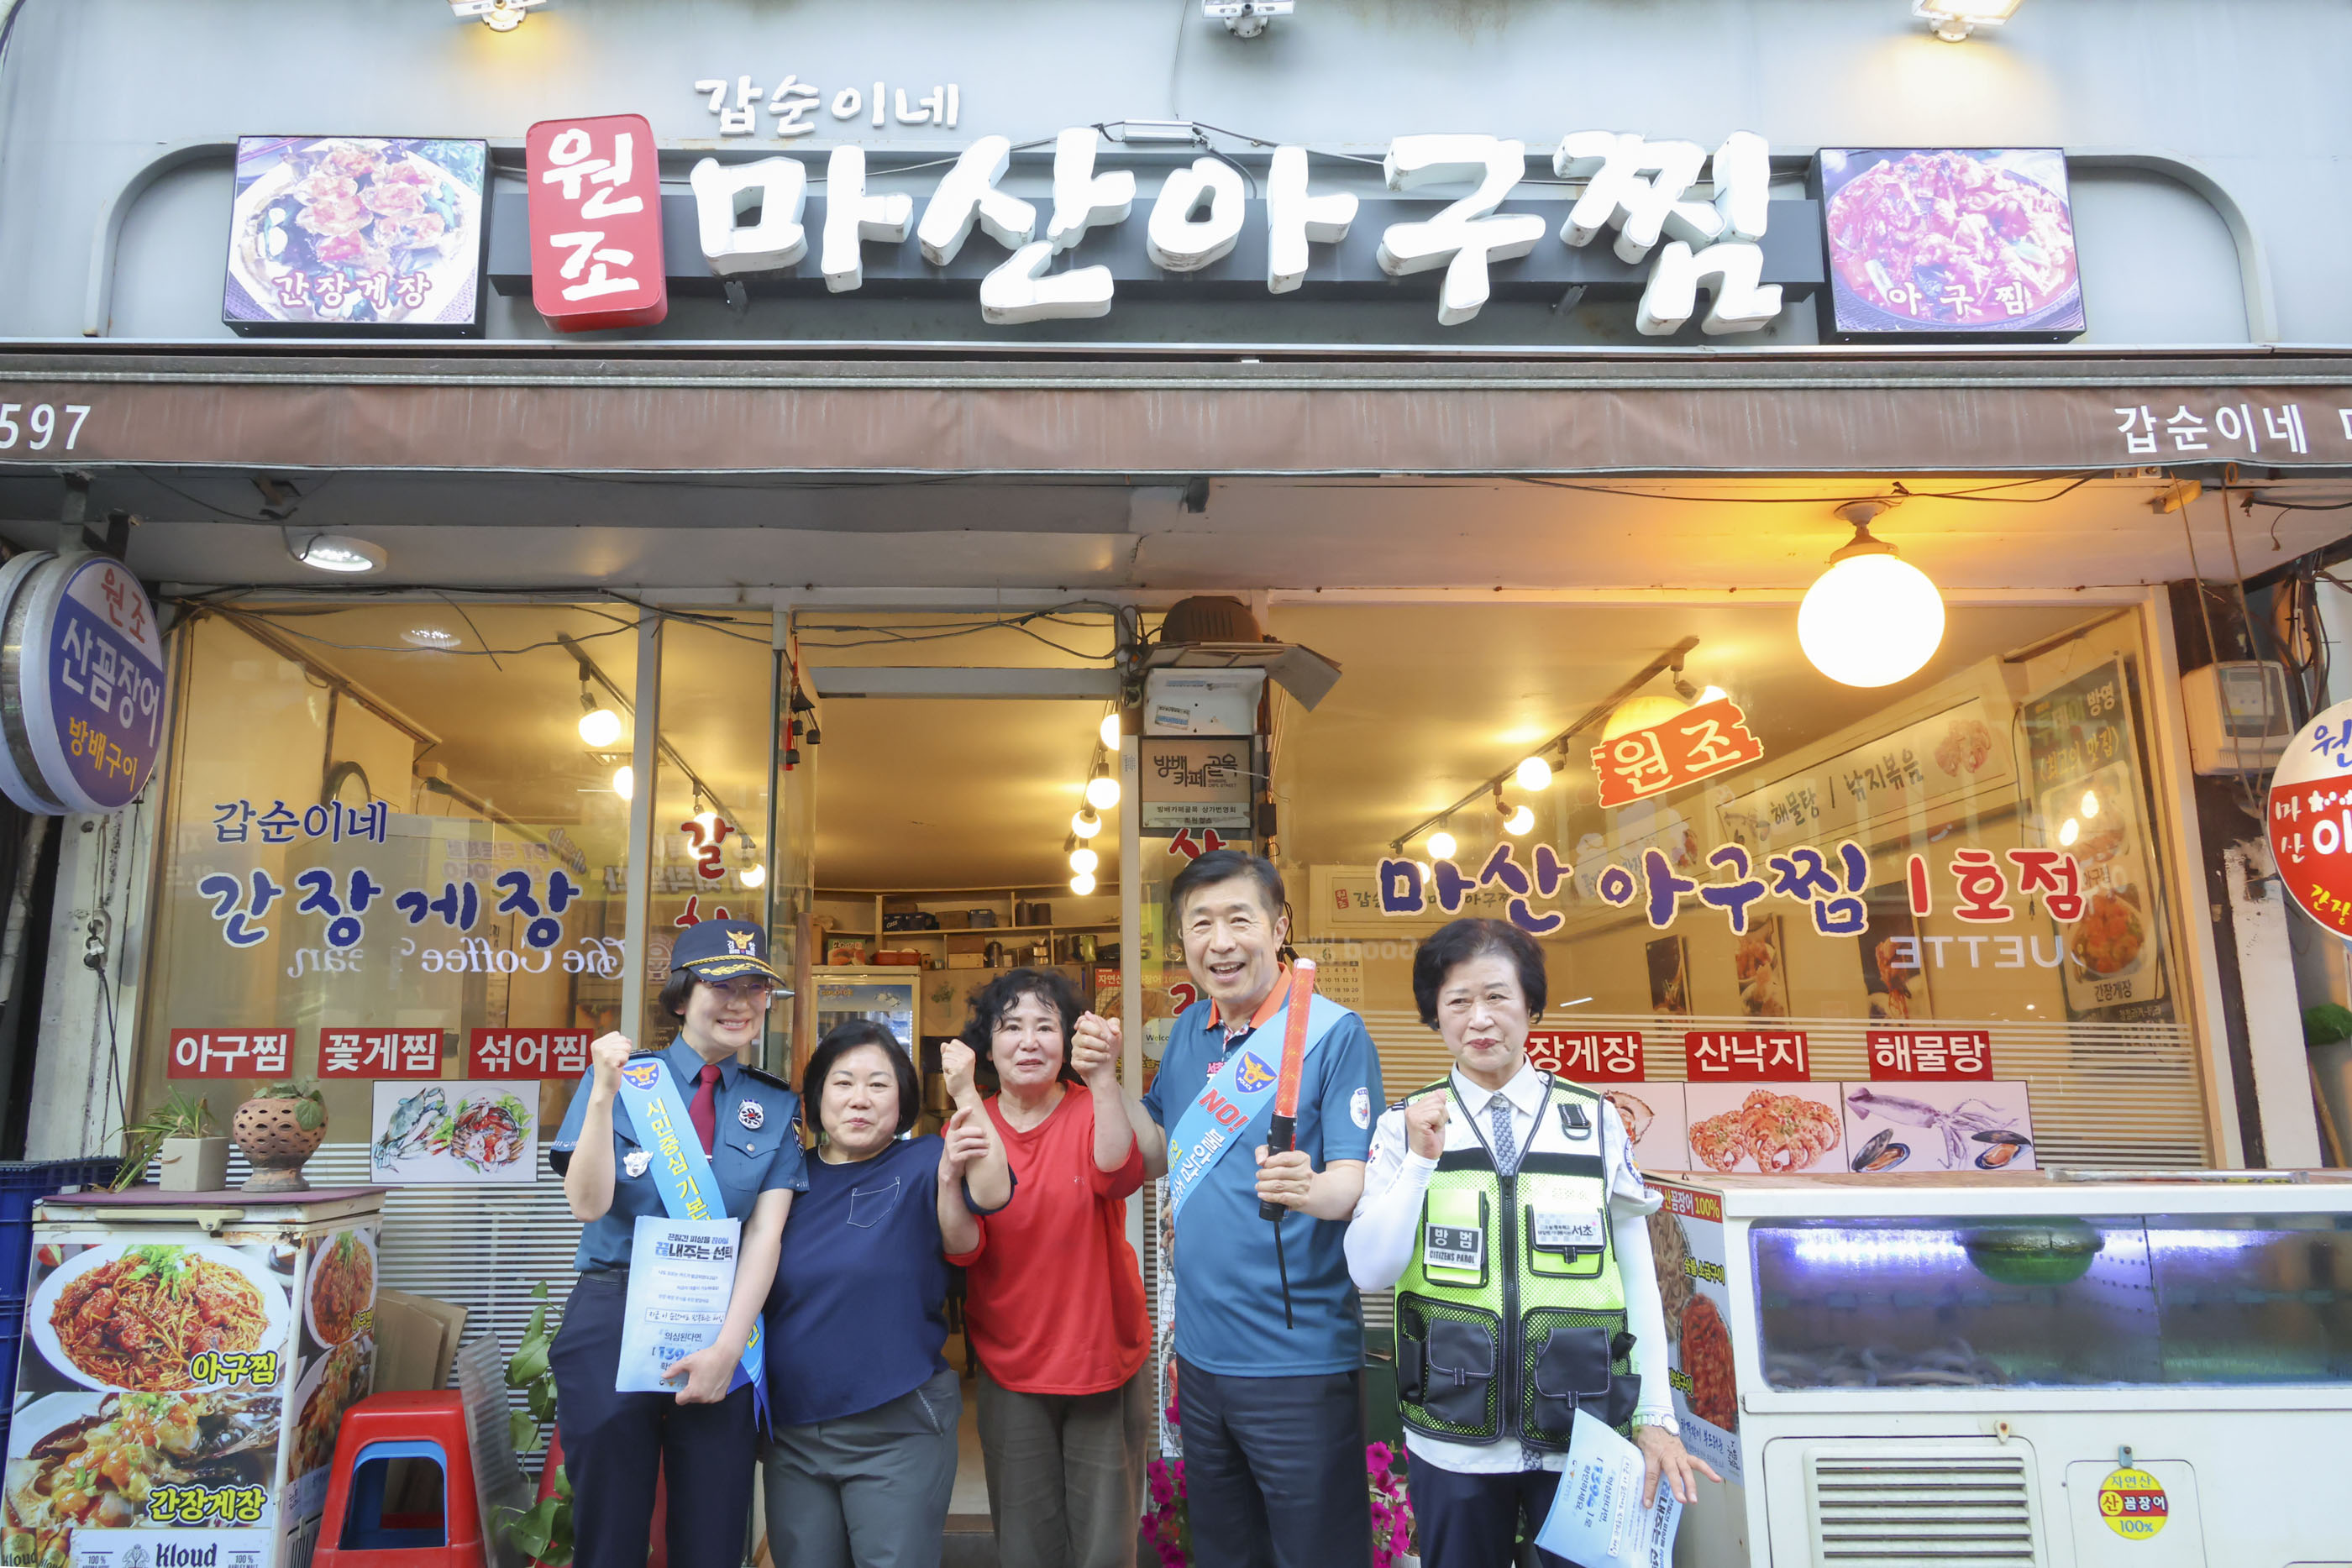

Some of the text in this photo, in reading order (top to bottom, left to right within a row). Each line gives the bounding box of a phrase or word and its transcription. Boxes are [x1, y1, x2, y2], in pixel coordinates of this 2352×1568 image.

[695, 74, 960, 138] 갑순이네
[542, 128, 644, 302] 원조
[690, 127, 1783, 335] 마산아구찜
[271, 271, 432, 311] 간장게장
[1887, 281, 2030, 316] 아구찜
[2113, 404, 2308, 454] 갑순이네
[101, 568, 145, 644] 원조
[2087, 681, 2115, 716] 방영
[69, 716, 138, 792] 방배구이
[1614, 720, 1740, 794] 원조
[213, 800, 386, 844] 갑순이네
[1771, 788, 1820, 826] 해물탕
[1377, 842, 1573, 936] 마산
[1597, 840, 1869, 936] 아구찜
[197, 867, 582, 950] 간장게장
[2094, 980, 2132, 1003] 간장게장
[176, 1034, 288, 1072] 아구찜
[324, 1033, 437, 1072] 꽃게찜
[476, 1033, 586, 1072] 섞어찜
[1524, 1035, 1638, 1073] 장게장
[1694, 1035, 1804, 1073] 산낙지
[1874, 1034, 1984, 1072] 해물탕
[1199, 1088, 1249, 1133] NO!
[646, 1097, 712, 1221] 시민중심 기본
[1694, 1197, 1720, 1219] 100%
[1572, 1225, 1593, 1236] 서초
[1698, 1260, 1725, 1285] 소금구이
[659, 1346, 693, 1361] 139
[664, 1332, 703, 1342] 의심된다면,
[189, 1350, 280, 1385] 아구찜
[2110, 1476, 2150, 1488] 자연산
[149, 1485, 269, 1523] 간장게장
[2119, 1520, 2154, 1533] 100%
[155, 1543, 218, 1568] Kloud
